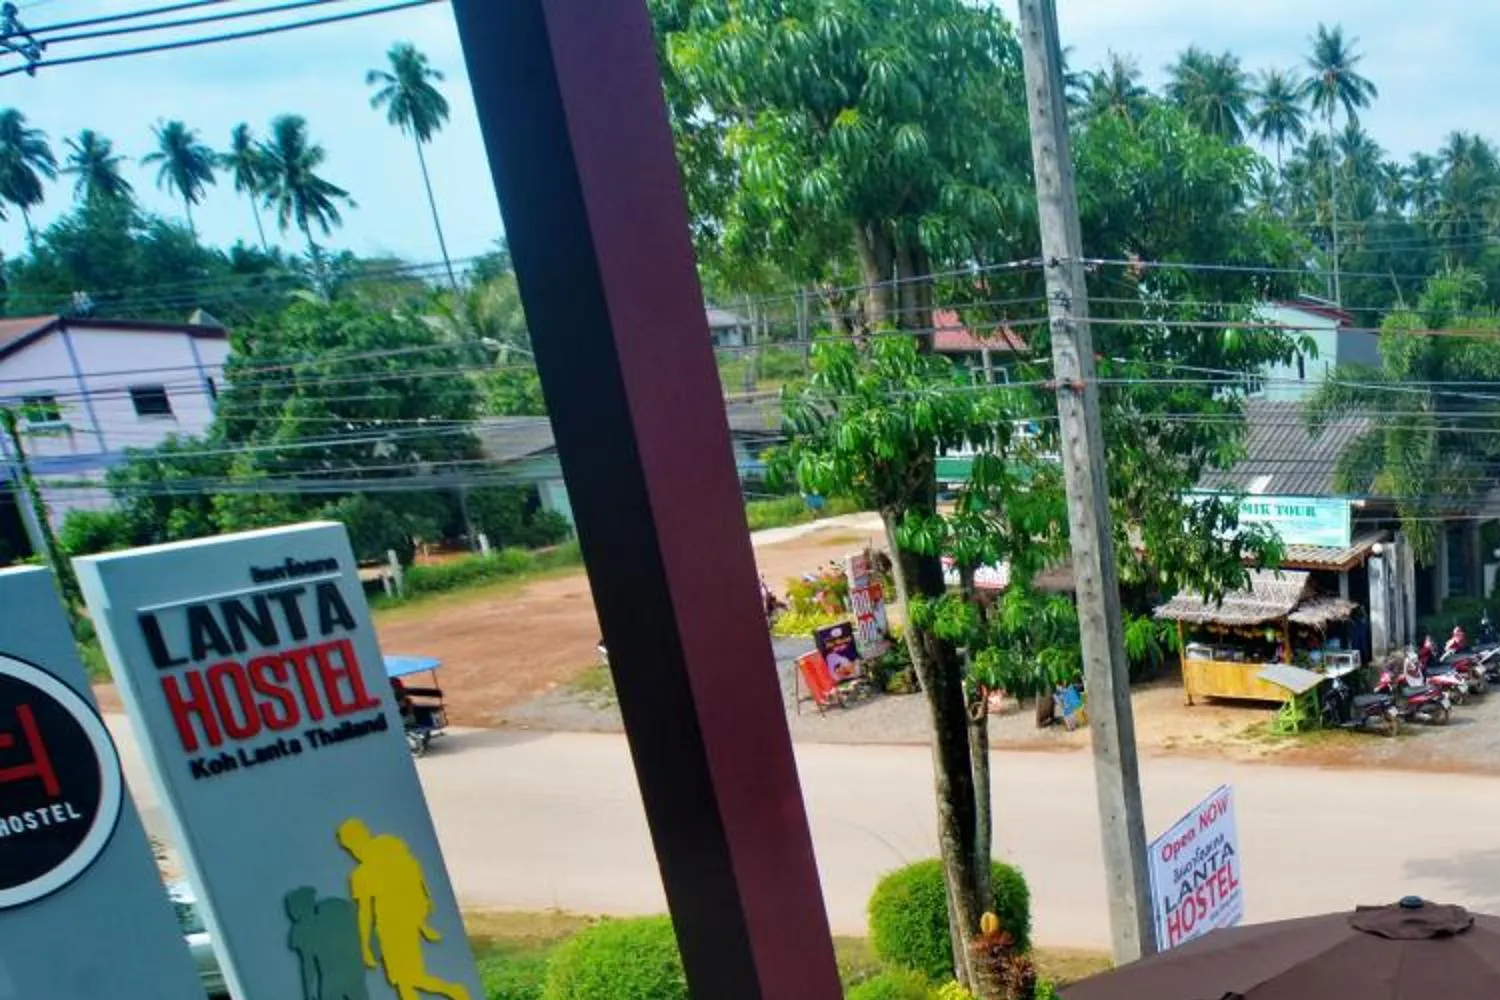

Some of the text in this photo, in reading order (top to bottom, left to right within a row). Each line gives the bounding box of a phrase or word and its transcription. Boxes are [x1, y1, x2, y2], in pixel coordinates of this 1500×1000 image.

[1274, 503, 1317, 517] TOUR
[138, 581, 356, 669] LANTA
[160, 638, 383, 754] HOSTEL
[187, 711, 389, 781] Koh Lanta Thailand
[1161, 796, 1229, 862] Open NOW
[1165, 842, 1235, 914] LANTA
[1167, 860, 1238, 947] HOSTEL
